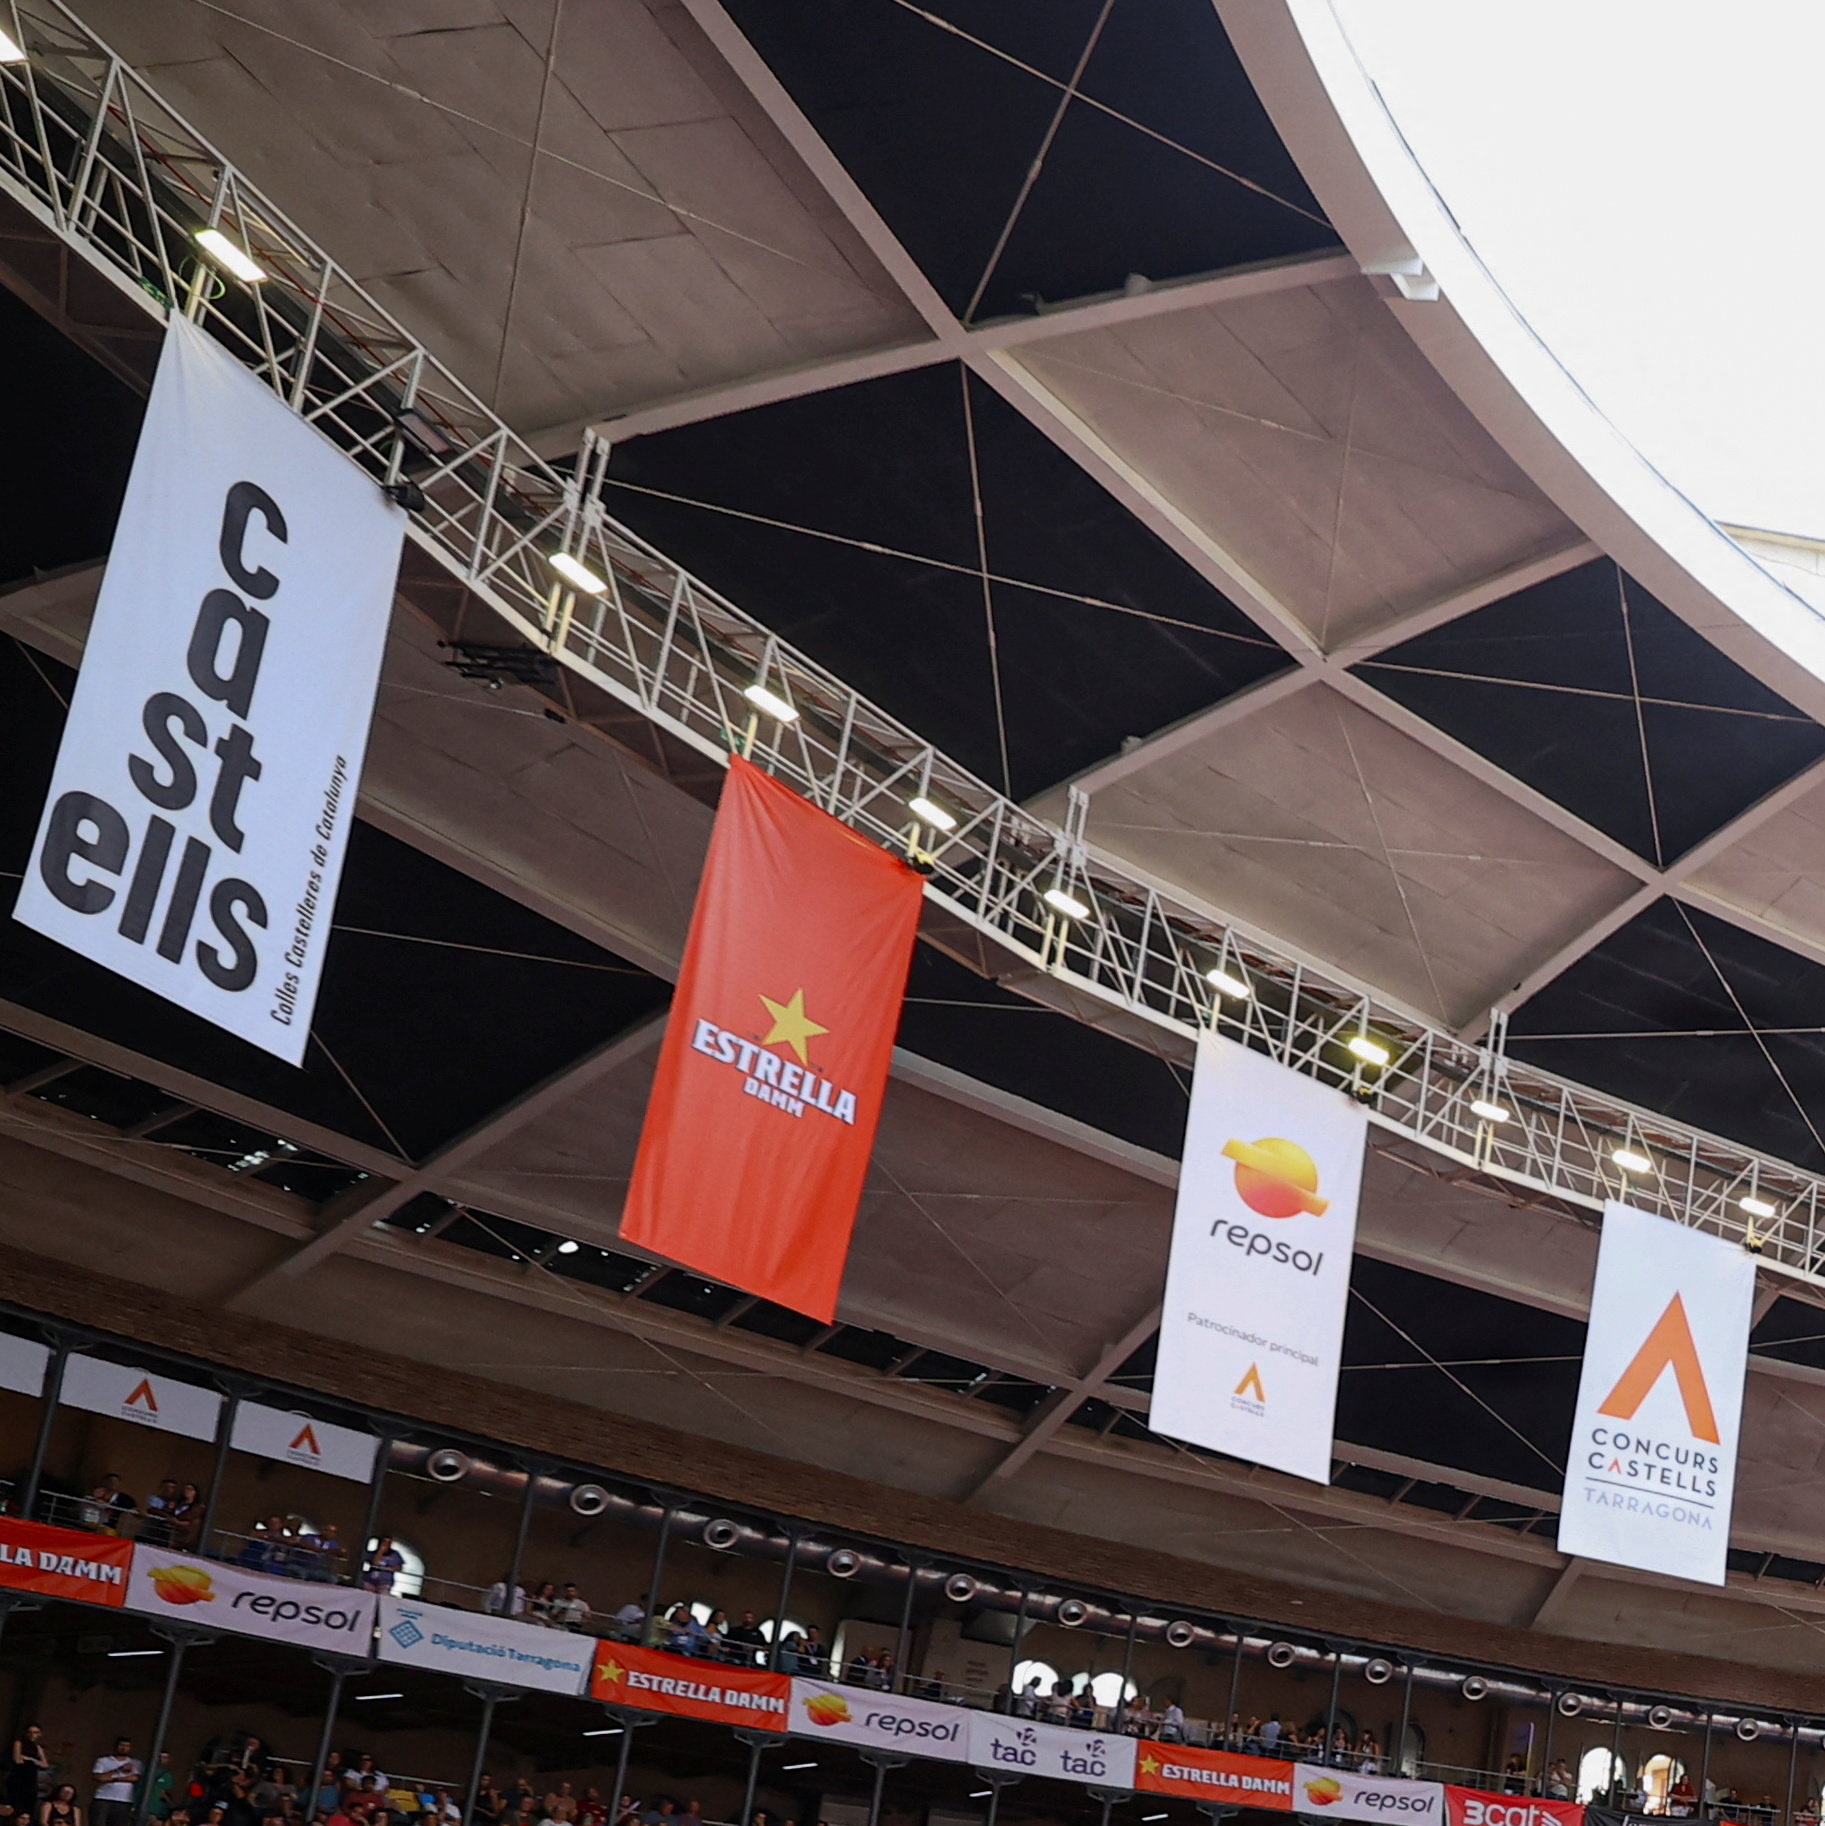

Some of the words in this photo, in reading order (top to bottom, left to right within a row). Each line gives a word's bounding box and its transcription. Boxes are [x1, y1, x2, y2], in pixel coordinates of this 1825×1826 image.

[316, 755, 348, 841] Catalunya
[311, 840, 330, 870] de
[283, 873, 324, 957] Castelleres
[270, 957, 306, 1027] Colles
[691, 1018, 859, 1125] ESTRELLA
[741, 1077, 804, 1119] DAMM
[1209, 1217, 1326, 1277] repsol
[1187, 1312, 1268, 1350] Patrocinador
[1269, 1337, 1320, 1369] principal
[1591, 1427, 1720, 1475] CONCURS
[1587, 1452, 1718, 1498] CASTELLS
[1583, 1487, 1713, 1531] TARRAGONA
[39, 1551, 122, 1585] DAMM
[231, 1590, 362, 1632] repsol
[431, 1631, 505, 1659] Diputació
[507, 1644, 581, 1675] Tarragona
[627, 1670, 722, 1704] ESTRELLA
[725, 1689, 784, 1714] DAMM
[864, 1711, 961, 1744] repsol
[991, 1734, 1037, 1768] tac
[1060, 1747, 1107, 1779] tac
[1162, 1763, 1239, 1789] ESTRELLA
[1241, 1774, 1292, 1796] DAMM
[1353, 1788, 1435, 1815] repsol
